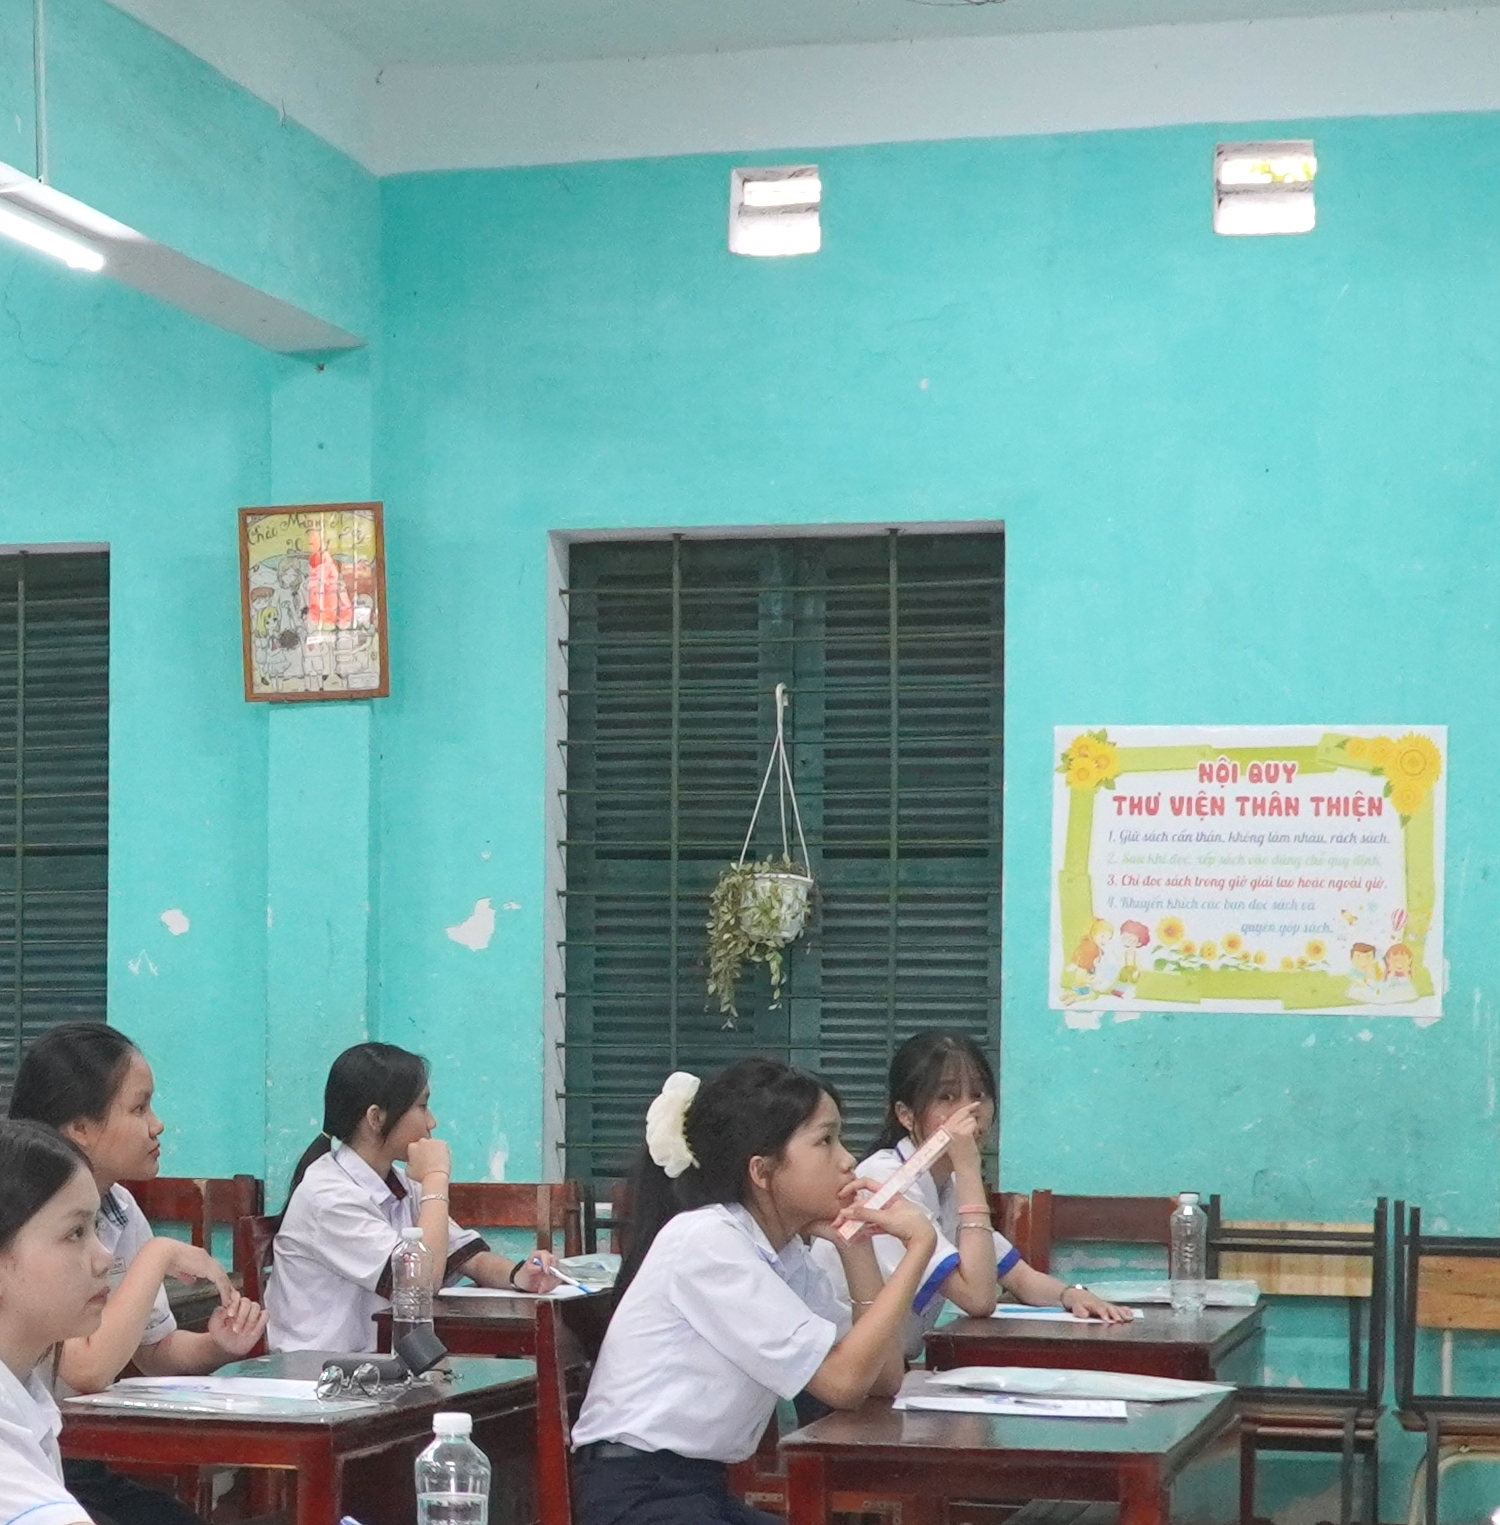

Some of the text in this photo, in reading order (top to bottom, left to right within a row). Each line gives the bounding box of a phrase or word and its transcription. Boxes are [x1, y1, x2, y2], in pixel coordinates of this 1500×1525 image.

[1199, 755, 1297, 788] NỘI QUY
[1113, 790, 1383, 822] THƯ VIỆN THÂN THIỆN
[1107, 873, 1118, 886] 3.
[1165, 874, 1191, 887] sách
[1195, 876, 1225, 890] trong
[1276, 876, 1295, 888] lao
